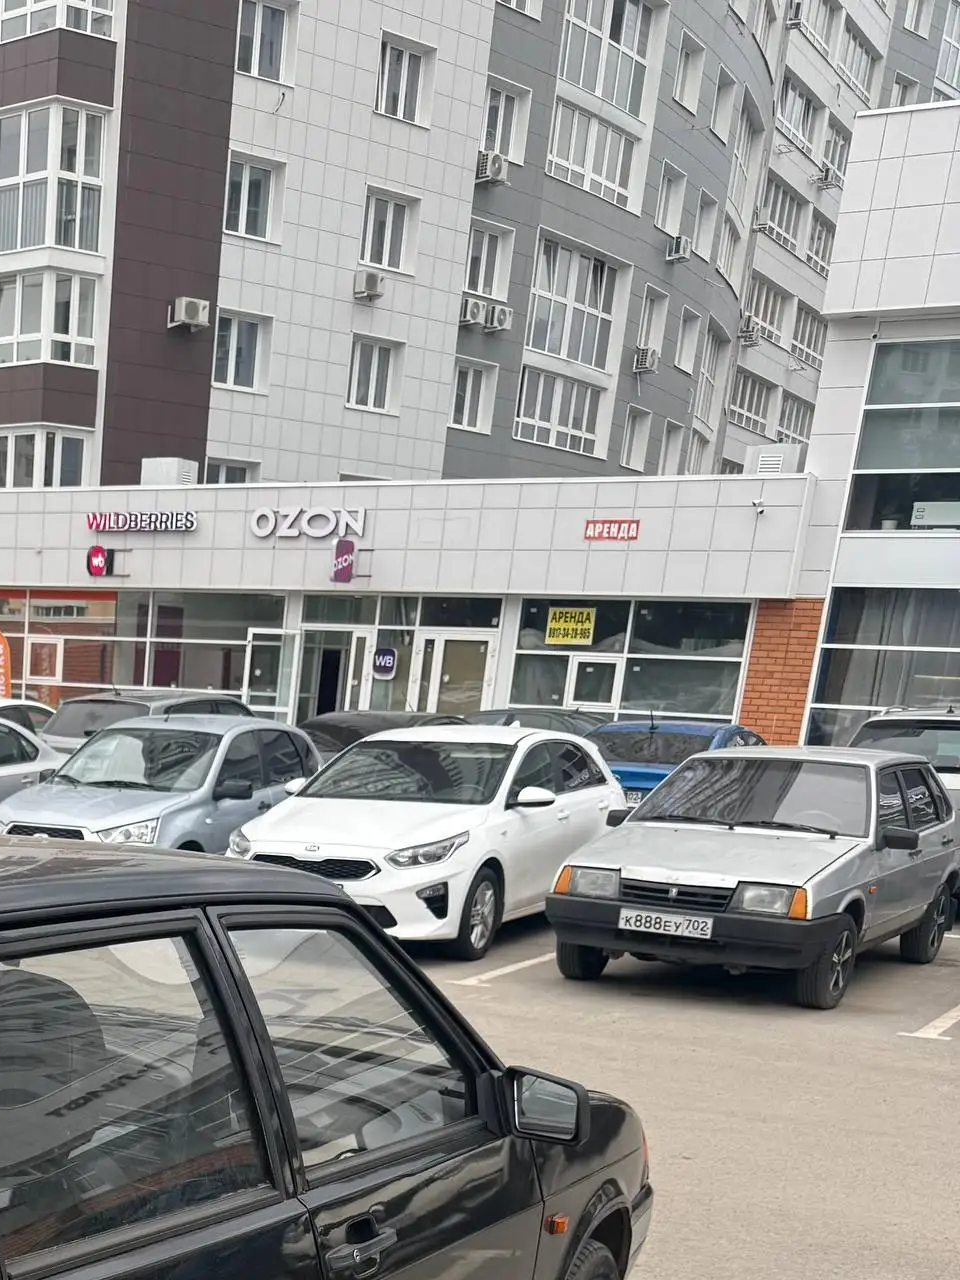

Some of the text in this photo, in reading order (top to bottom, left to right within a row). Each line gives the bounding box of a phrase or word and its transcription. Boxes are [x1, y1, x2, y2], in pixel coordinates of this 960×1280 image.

[85, 511, 197, 532] WILDBERRIES
[251, 507, 366, 538] OZON
[585, 522, 637, 540] АРЕНДА
[550, 611, 592, 626] АРЕНДА
[375, 655, 394, 667] WB
